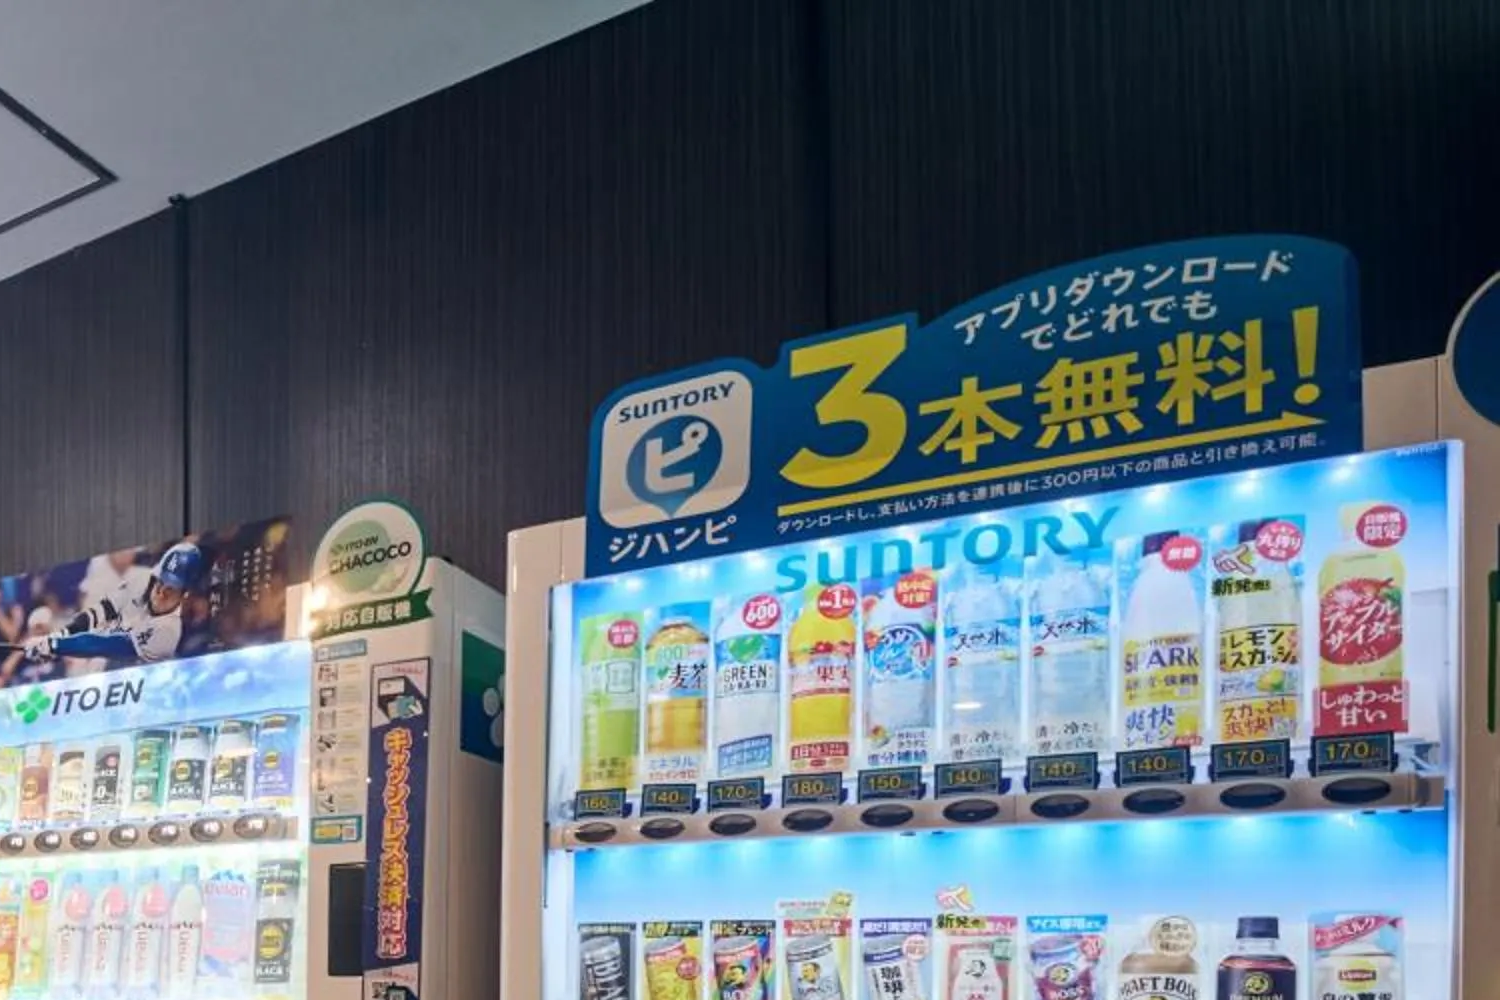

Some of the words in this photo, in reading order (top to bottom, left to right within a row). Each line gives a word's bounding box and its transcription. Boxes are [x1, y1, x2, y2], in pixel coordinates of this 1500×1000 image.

[954, 250, 1294, 345] アプリダウンロード
[1020, 290, 1218, 351] でどれでも
[618, 380, 736, 425] SUNTORY
[608, 514, 738, 563] ジハンピ
[774, 504, 1122, 595] SUNTORY
[1363, 523, 1401, 541] 限定
[329, 541, 412, 575] CHACOCO
[1230, 628, 1285, 649] レモン
[51, 686, 99, 716] ITO
[103, 678, 146, 710] EN
[1319, 686, 1406, 710] しゅわっと
[1335, 704, 1388, 727] 甘い
